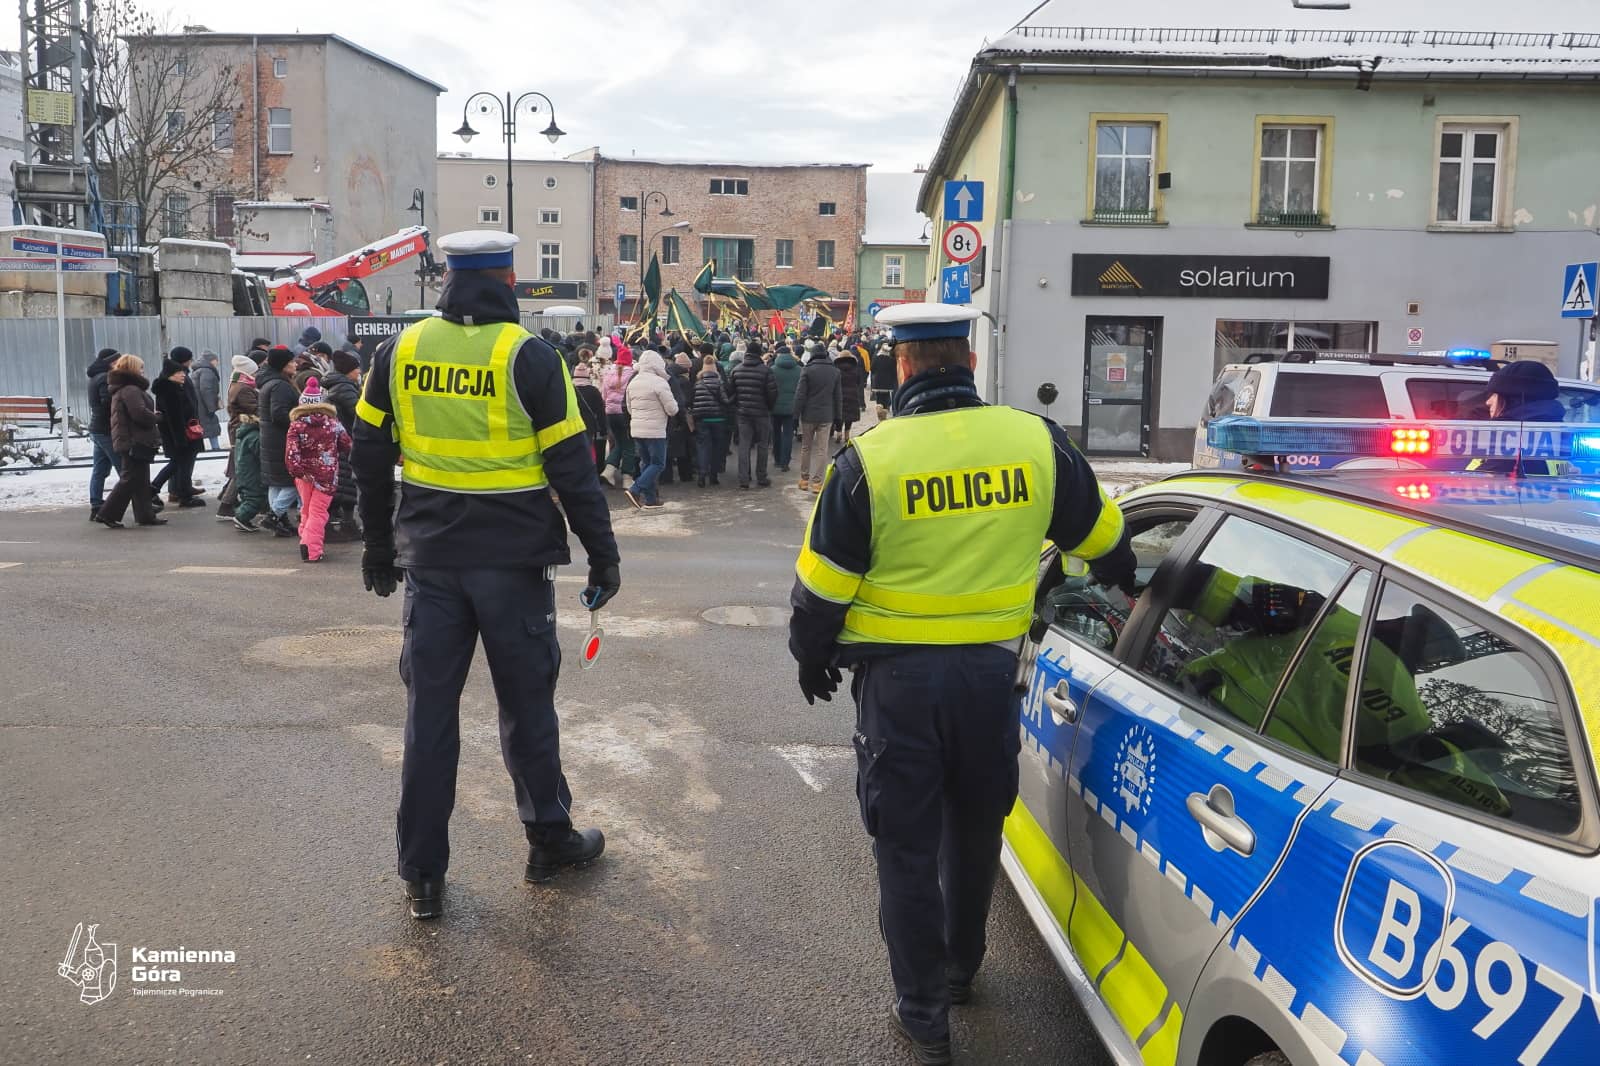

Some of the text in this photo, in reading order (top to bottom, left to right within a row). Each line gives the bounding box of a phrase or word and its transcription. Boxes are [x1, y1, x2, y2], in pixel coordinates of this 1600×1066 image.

[390, 242, 415, 260] MANITOU
[953, 235, 971, 251] 8t
[1180, 266, 1295, 288] solarium
[404, 364, 496, 398] POLICJA
[1433, 428, 1555, 458] POLICJA
[905, 467, 1029, 515] POLICJA
